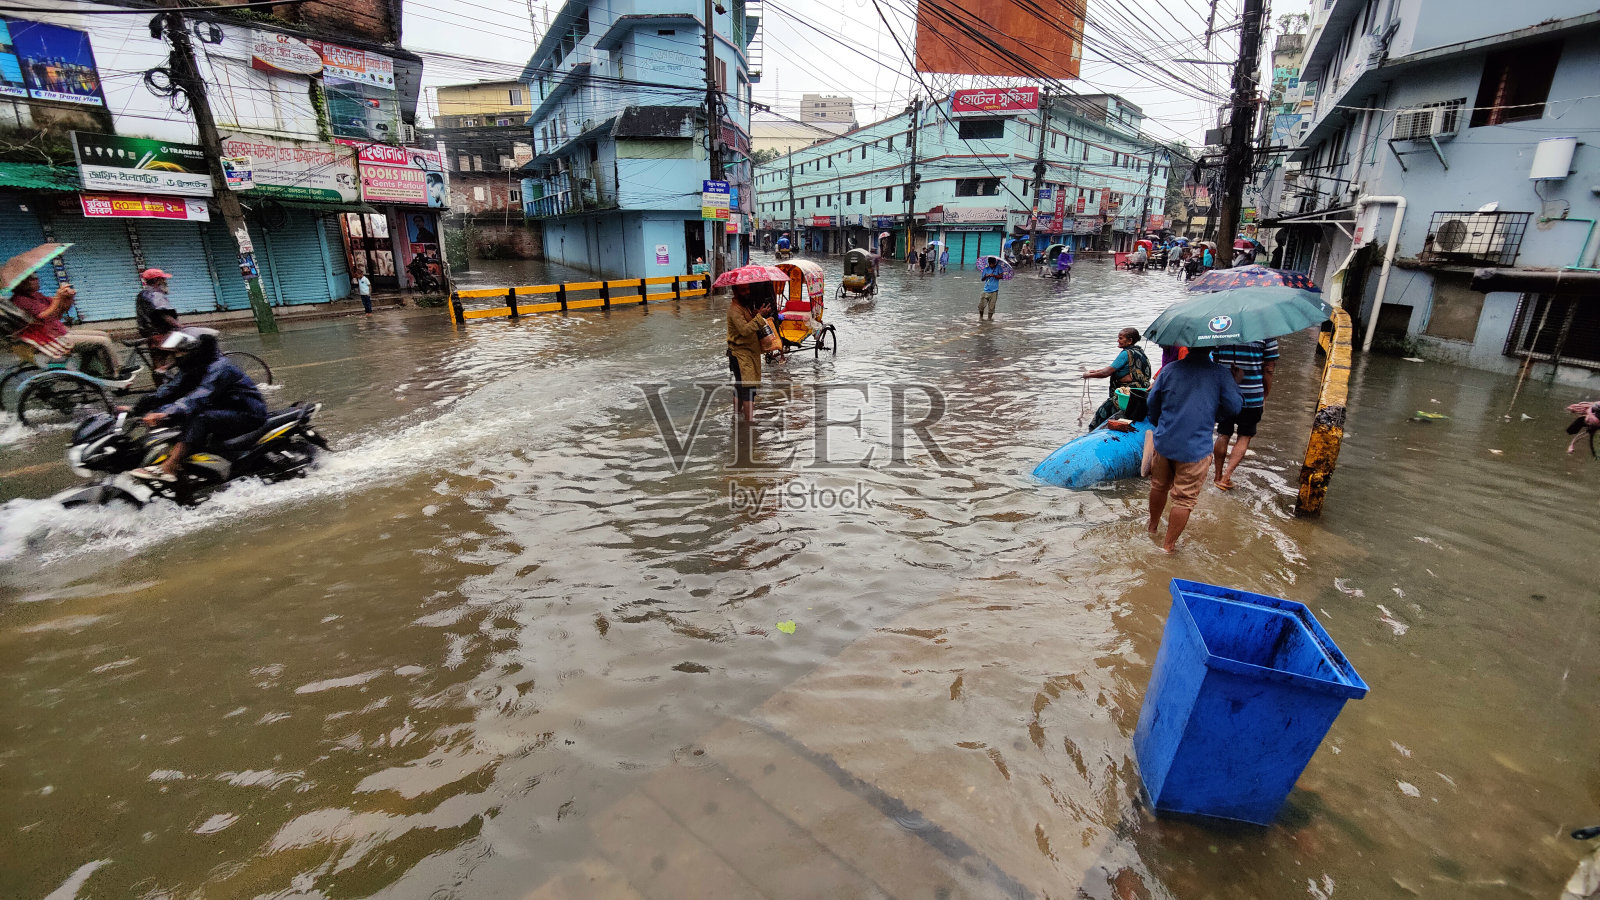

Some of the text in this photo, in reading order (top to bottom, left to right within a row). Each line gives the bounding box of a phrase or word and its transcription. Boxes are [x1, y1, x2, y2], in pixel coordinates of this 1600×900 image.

[959, 89, 1035, 108] হোটেল সুফিয়া
[169, 147, 204, 157] TRANSTEC
[361, 166, 425, 183] LOOKS HAIR
[372, 179, 395, 188] Gents
[397, 182, 425, 190] Parlour
